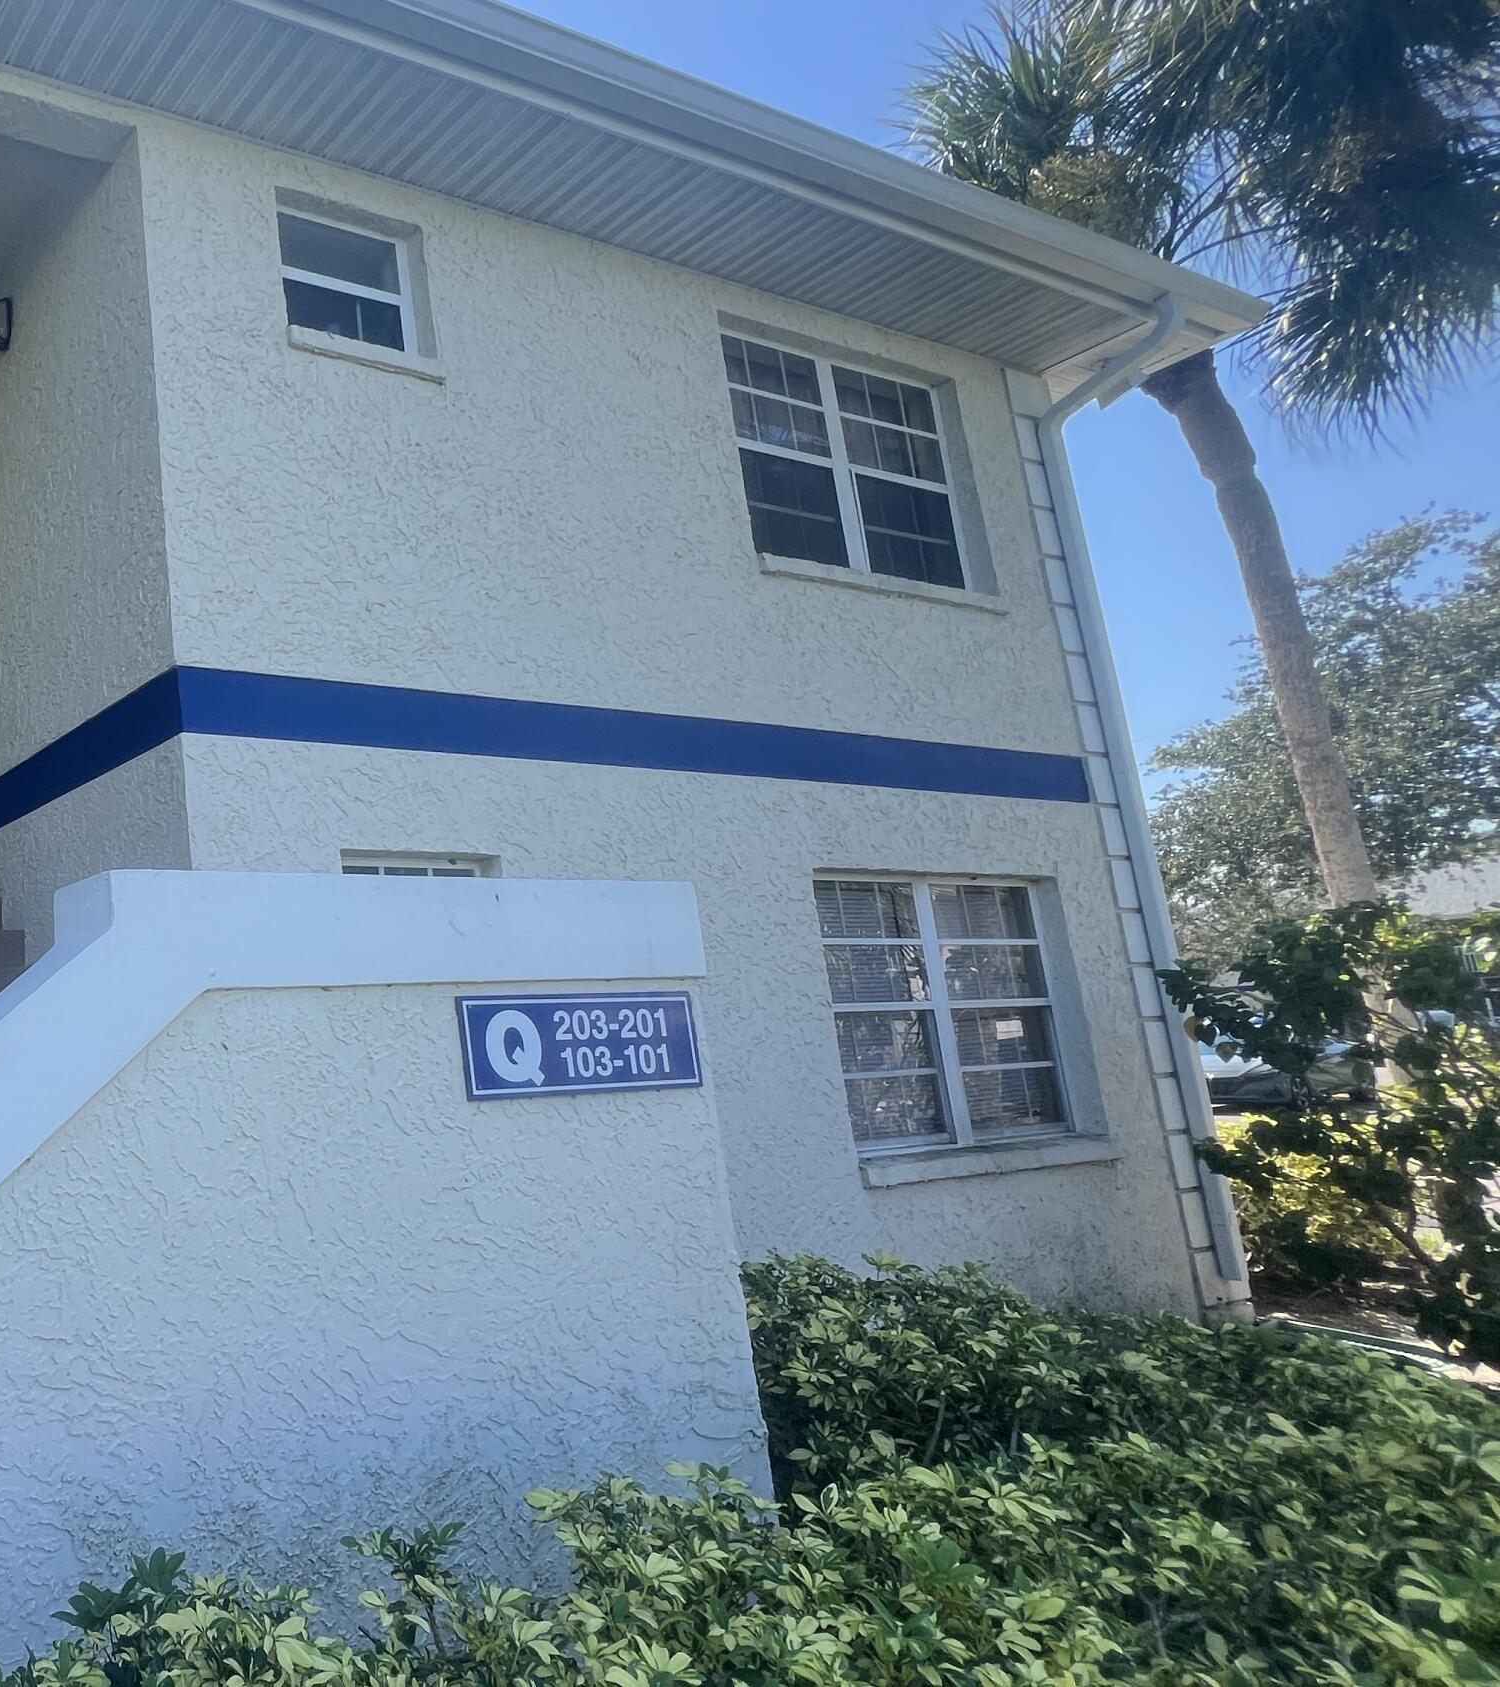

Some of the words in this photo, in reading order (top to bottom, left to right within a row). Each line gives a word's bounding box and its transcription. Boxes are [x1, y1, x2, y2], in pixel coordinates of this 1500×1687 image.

[553, 1008, 668, 1040] 203-201
[486, 1010, 545, 1086] Q
[560, 1044, 670, 1077] 103-101
